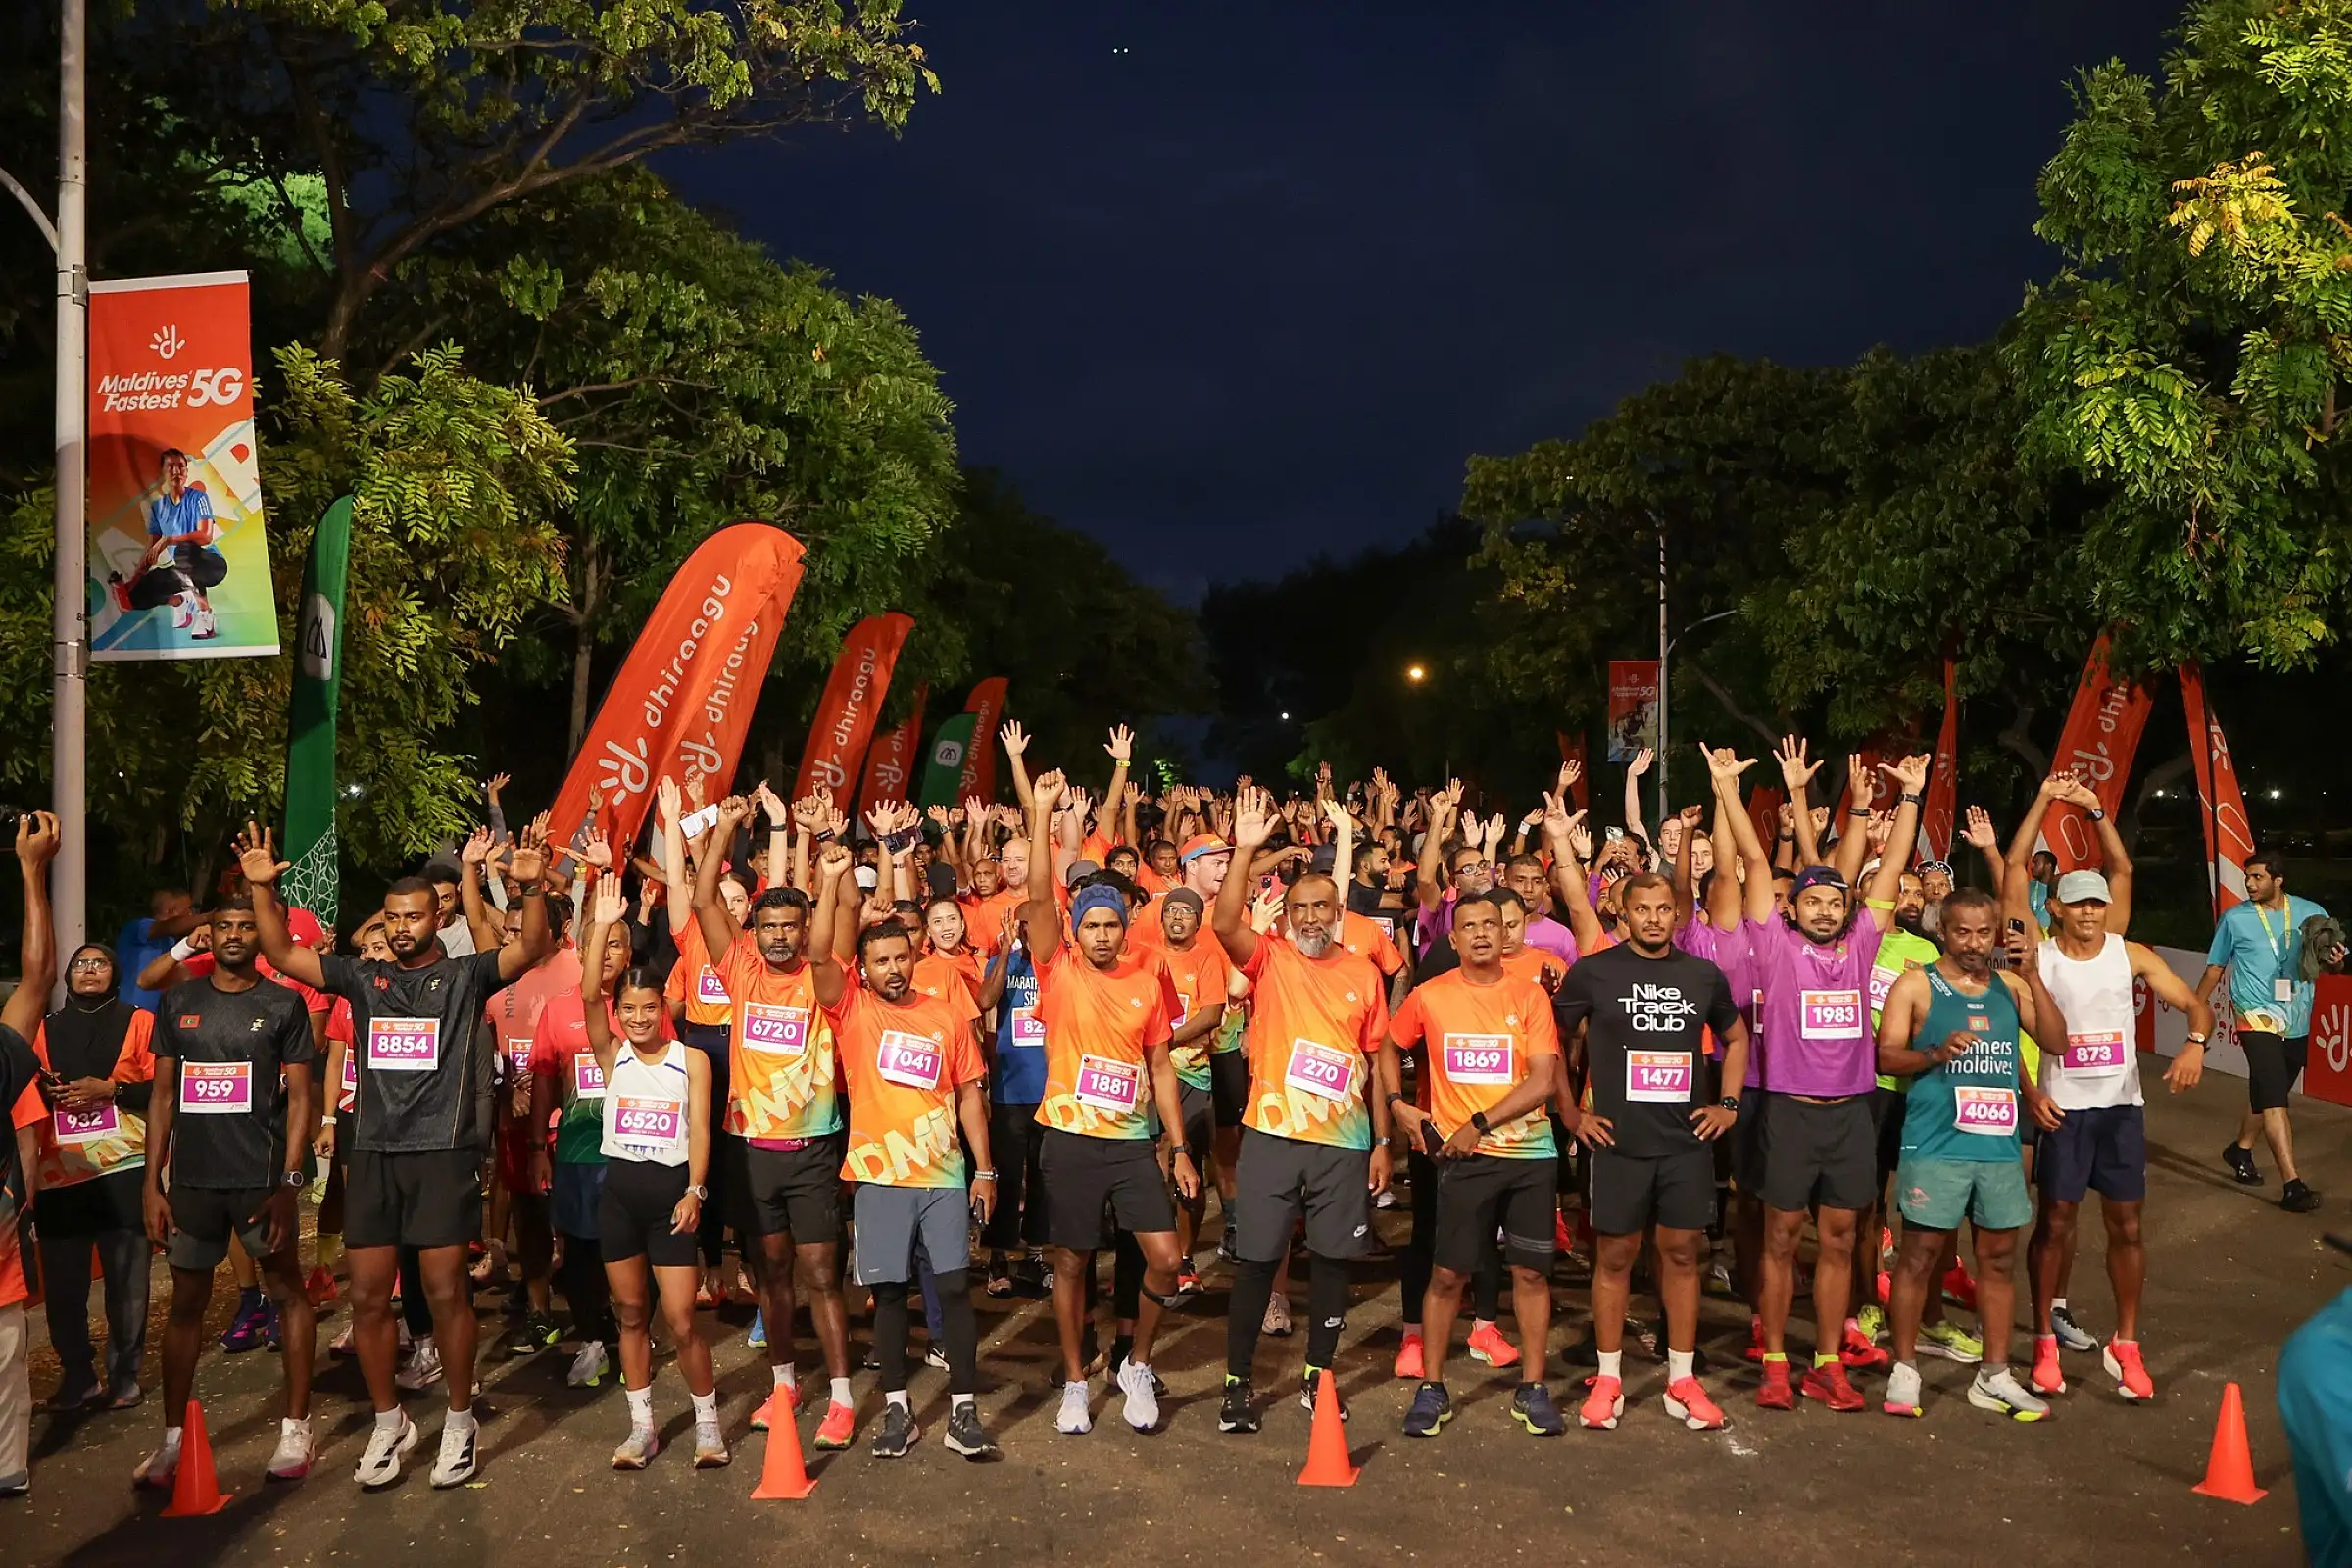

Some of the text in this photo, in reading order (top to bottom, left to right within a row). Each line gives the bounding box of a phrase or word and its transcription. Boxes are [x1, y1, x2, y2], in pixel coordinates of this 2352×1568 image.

[186, 367, 243, 408] 5G
[103, 389, 181, 412] Fastest
[644, 573, 731, 728] dhiraagu
[834, 647, 876, 747] dhiraagu
[1632, 983, 1682, 1000] Nike
[1617, 997, 1698, 1015] Track
[1812, 1006, 1855, 1023] 1983
[752, 1019, 797, 1040] 6720
[1023, 1020, 1046, 1034] 82
[1632, 1013, 1686, 1032] Club
[377, 1035, 429, 1054] 8854
[2076, 1045, 2112, 1062] 873
[1454, 1050, 1501, 1068] 1869
[584, 1067, 604, 1083] 18
[1302, 1058, 1339, 1082] 270
[1640, 1067, 1685, 1086] 1477
[194, 1080, 234, 1097] 959
[1090, 1073, 1130, 1097] 1881
[67, 1111, 103, 1129] 932
[620, 1111, 671, 1131] 6520
[1964, 1102, 2010, 1121] 4066
